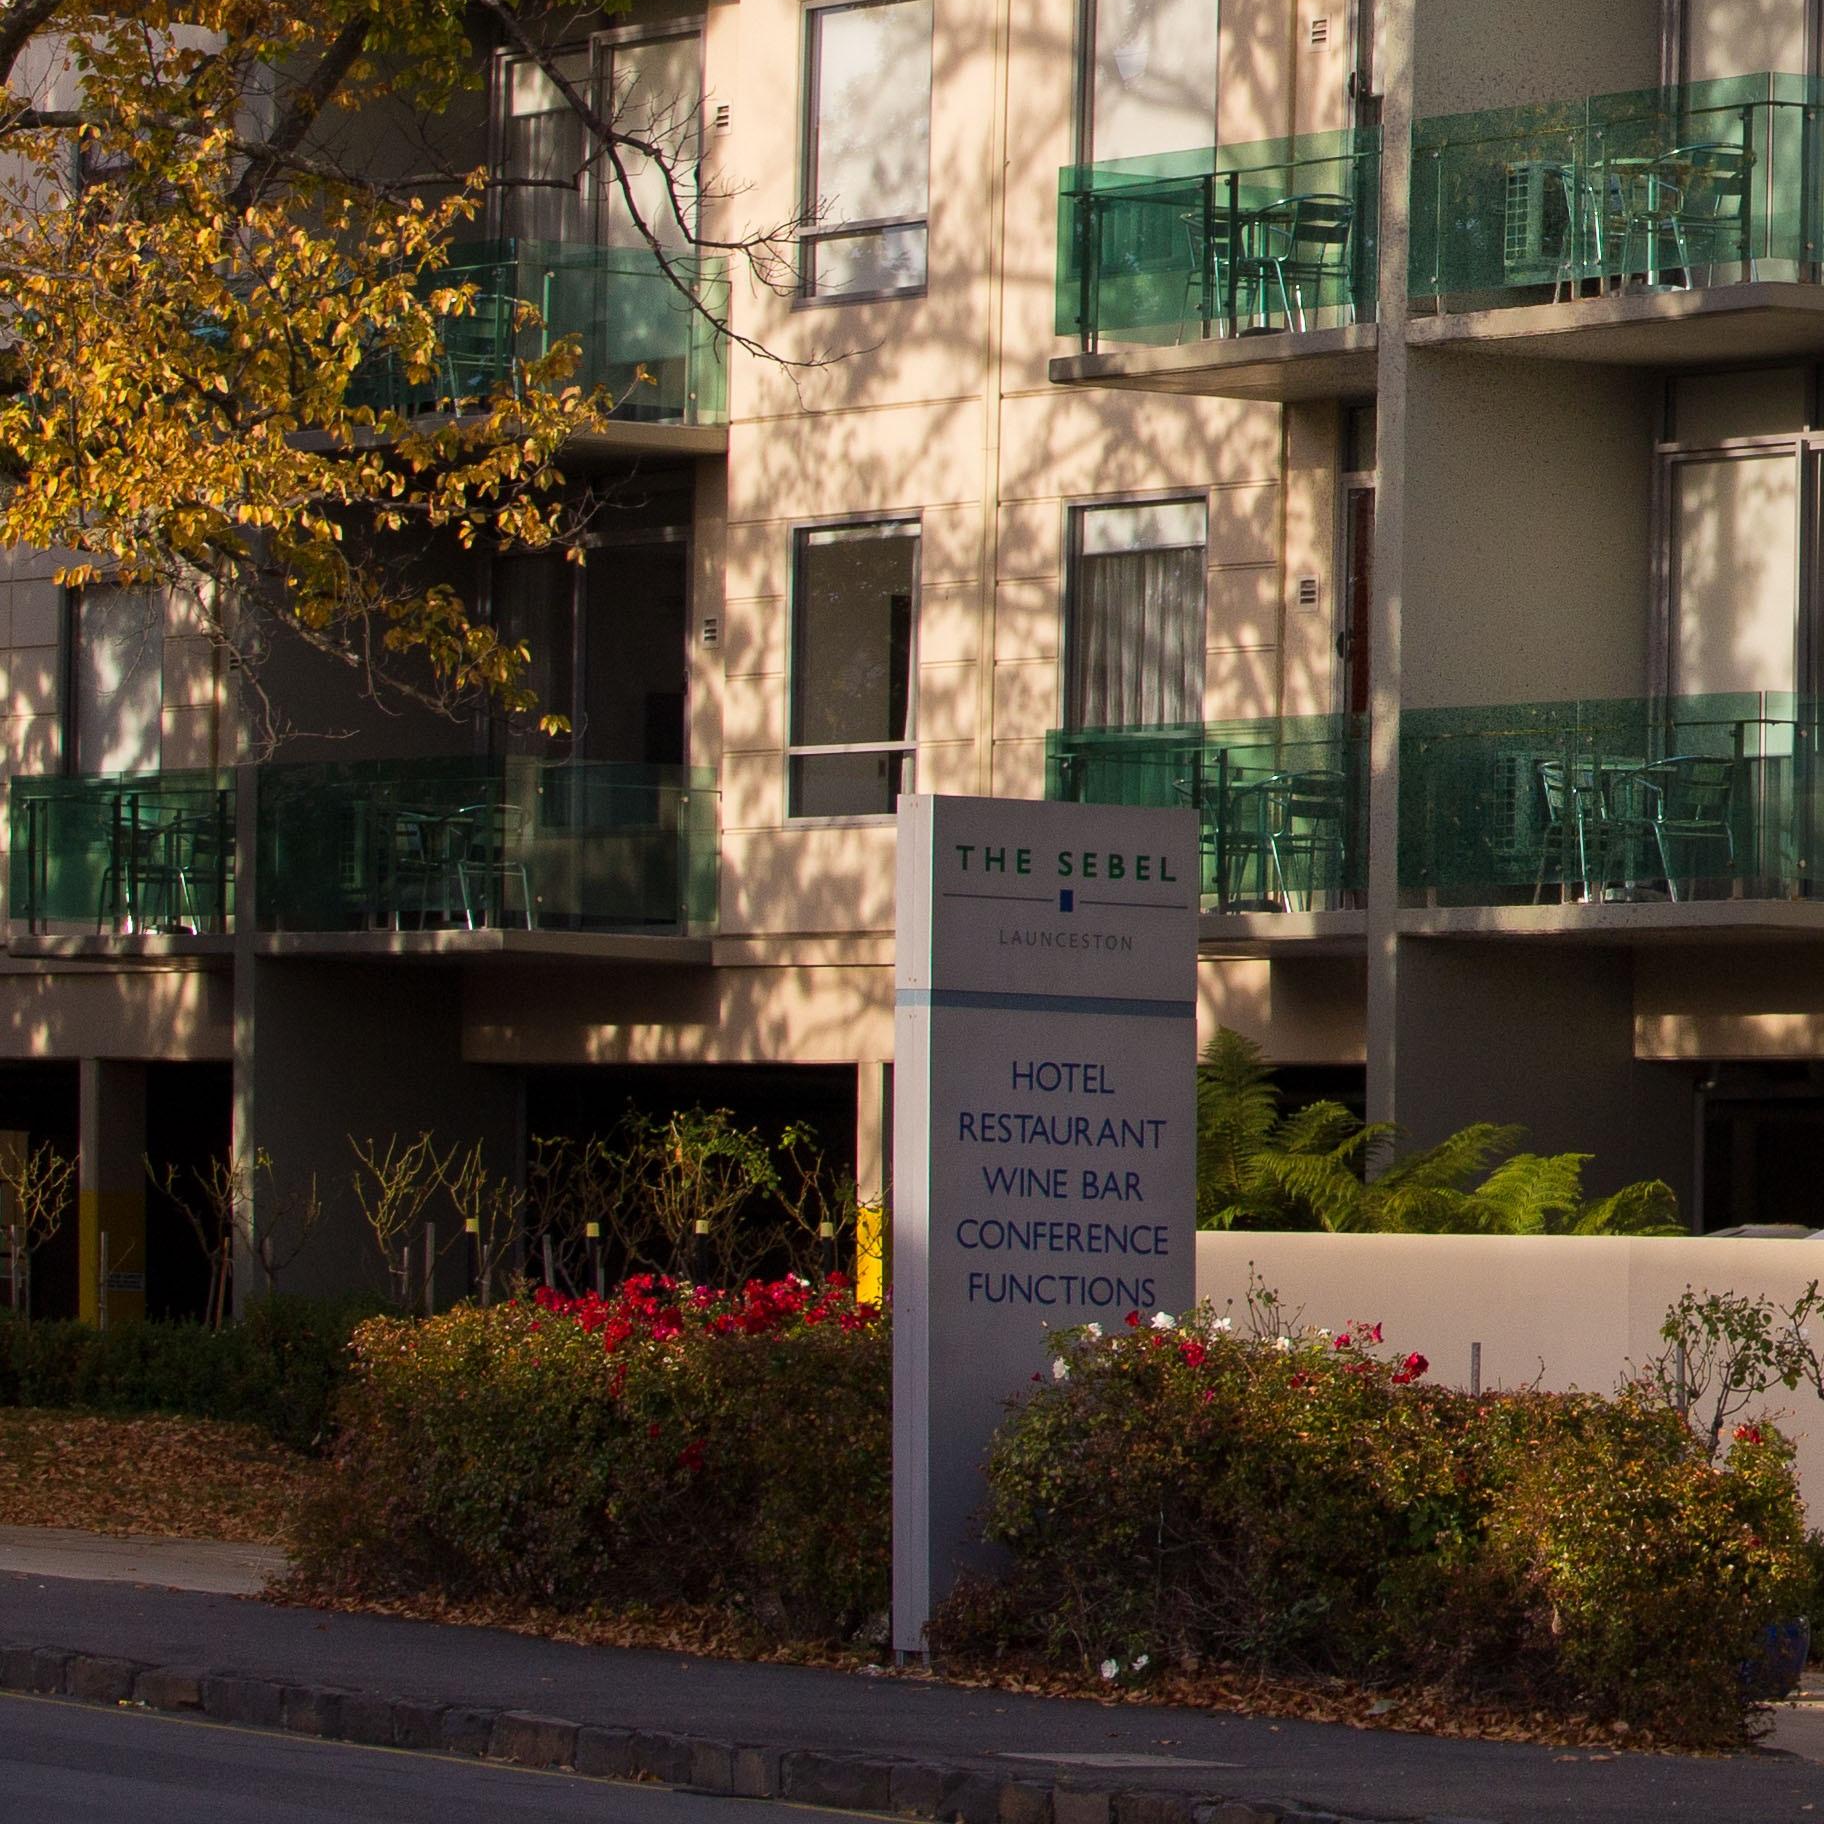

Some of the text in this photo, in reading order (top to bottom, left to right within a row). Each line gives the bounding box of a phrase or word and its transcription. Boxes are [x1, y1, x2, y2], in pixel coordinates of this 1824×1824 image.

[955, 844, 1178, 883] THE SEBEL
[999, 928, 1134, 952] LAUNCESTON
[1011, 1060, 1115, 1095] HOTEL
[958, 1112, 1168, 1150] RESTAURANT
[982, 1166, 1145, 1202] WINE BAR
[956, 1218, 1170, 1256] CONFERENCE
[968, 1273, 1156, 1308] FUNCTIONS
